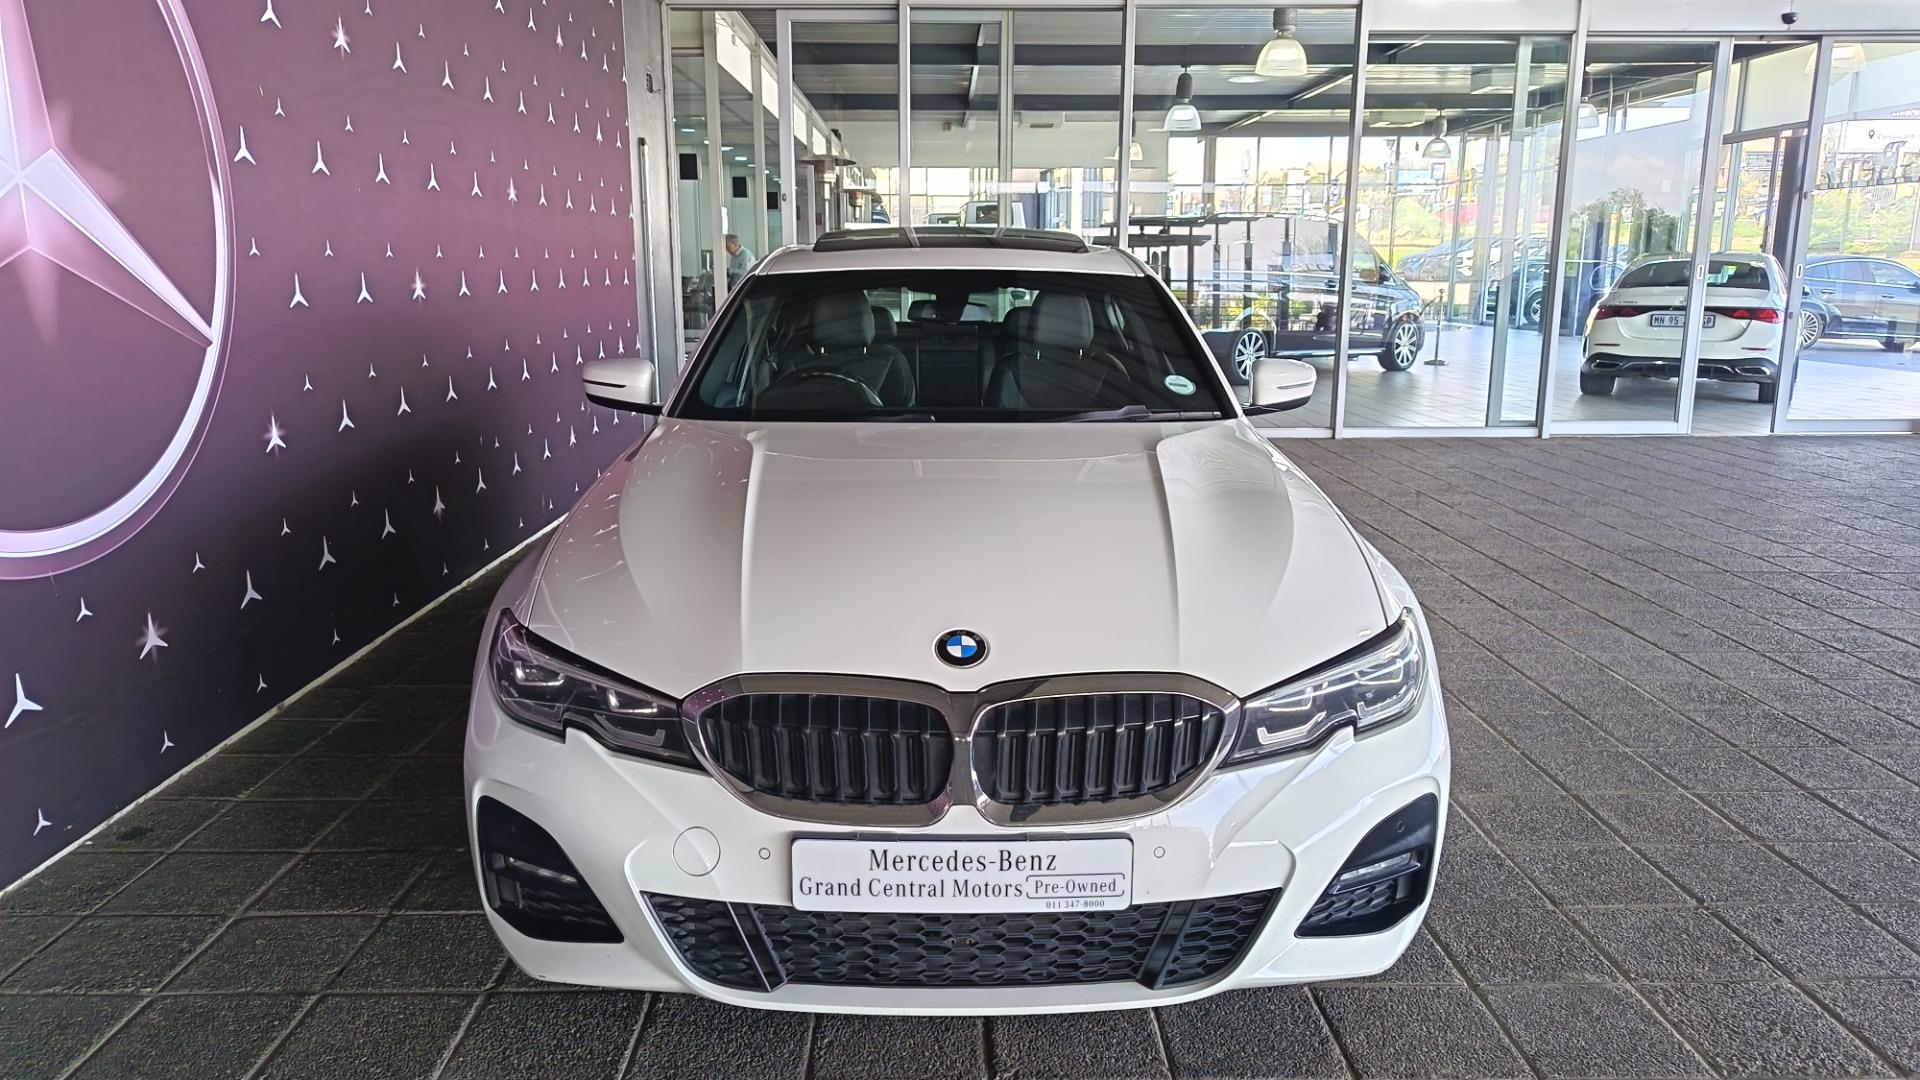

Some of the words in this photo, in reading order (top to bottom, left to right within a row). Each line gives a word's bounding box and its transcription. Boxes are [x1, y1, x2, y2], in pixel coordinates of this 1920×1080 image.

[1653, 315, 1665, 325] MN
[1669, 316, 1679, 325] 95
[869, 849, 1057, 871] Mercedes-Benz
[799, 876, 861, 896] Grand
[868, 878, 944, 898] Central
[952, 879, 1023, 898] Motors
[1034, 878, 1116, 894] Pre-Owned
[1046, 901, 1061, 909] 011
[1065, 900, 1105, 909] 347-8000
